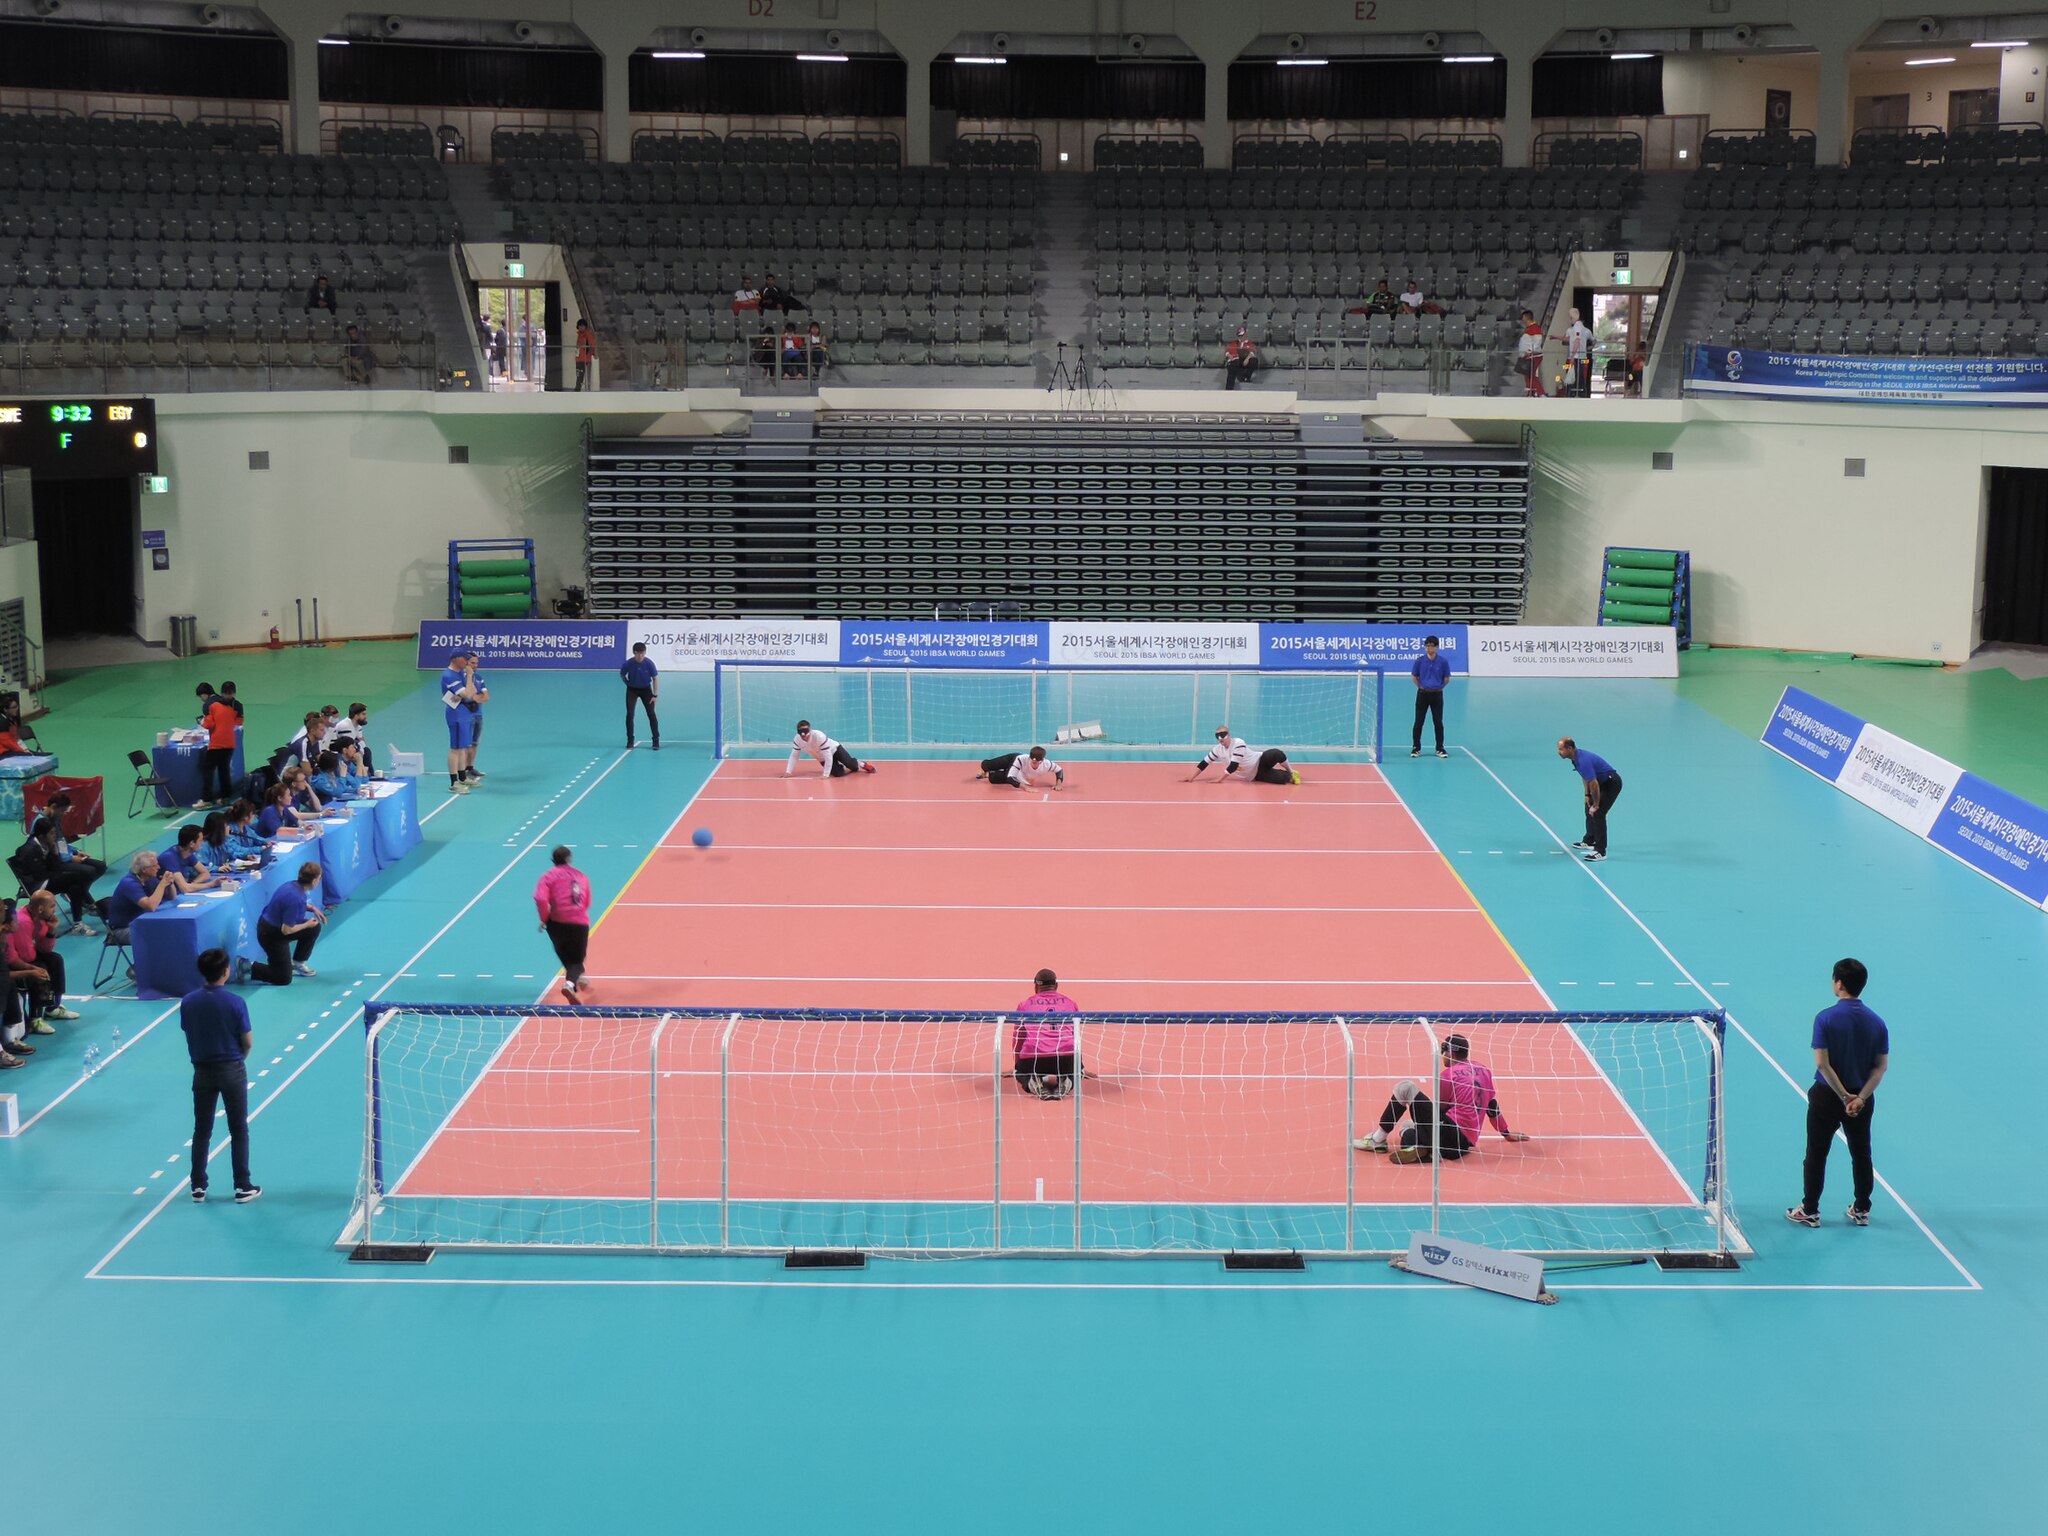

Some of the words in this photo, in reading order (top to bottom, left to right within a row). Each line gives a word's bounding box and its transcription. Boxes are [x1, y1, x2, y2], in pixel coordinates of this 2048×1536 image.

[749, 0, 774, 16] D2
[1355, 1, 1376, 20] E2
[1768, 356, 1790, 366] 2015
[1996, 363, 2048, 374] 기원합니다.
[50, 406, 92, 422] 9:32
[60, 432, 72, 448] F
[431, 634, 616, 648] 2015서울세계시각장애인경기대회
[644, 633, 828, 646] 2015서울세계시각장애인경기대회
[852, 633, 1038, 647] 2015서울세계시각장애인경기대회
[1062, 635, 1248, 649] 2015서울세계시각장애인경기대회
[1271, 636, 1456, 650] 2015서울세계시각장애인경회
[1481, 641, 1664, 653] 2015서울세계시각장애인경기대회
[1452, 1256, 1464, 1266] GS
